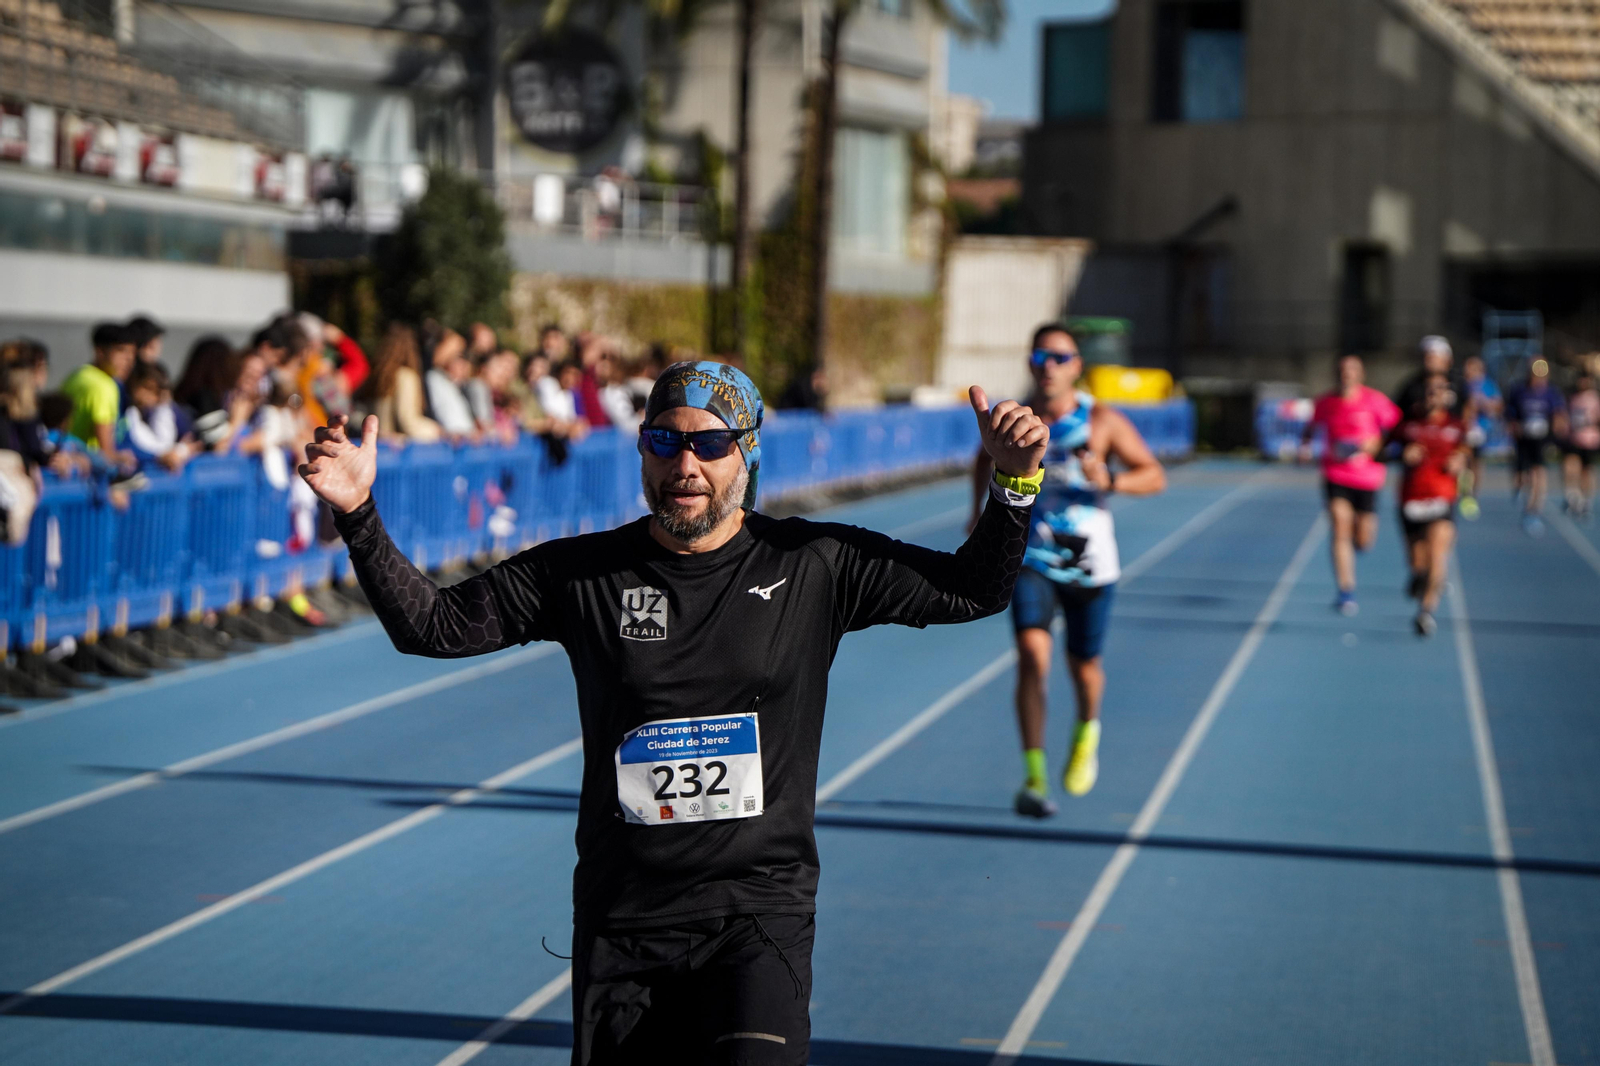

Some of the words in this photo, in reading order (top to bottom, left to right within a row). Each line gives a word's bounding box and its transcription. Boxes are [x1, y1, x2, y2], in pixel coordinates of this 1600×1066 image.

[627, 593, 663, 613] UZ
[625, 628, 662, 637] TRAIL
[636, 728, 658, 738] XLIII
[661, 725, 699, 735] Carrera
[701, 721, 742, 732] Popular
[647, 739, 684, 750] Ciudad
[686, 737, 699, 746] de
[701, 736, 730, 746] Jerez
[652, 760, 730, 801] 232
